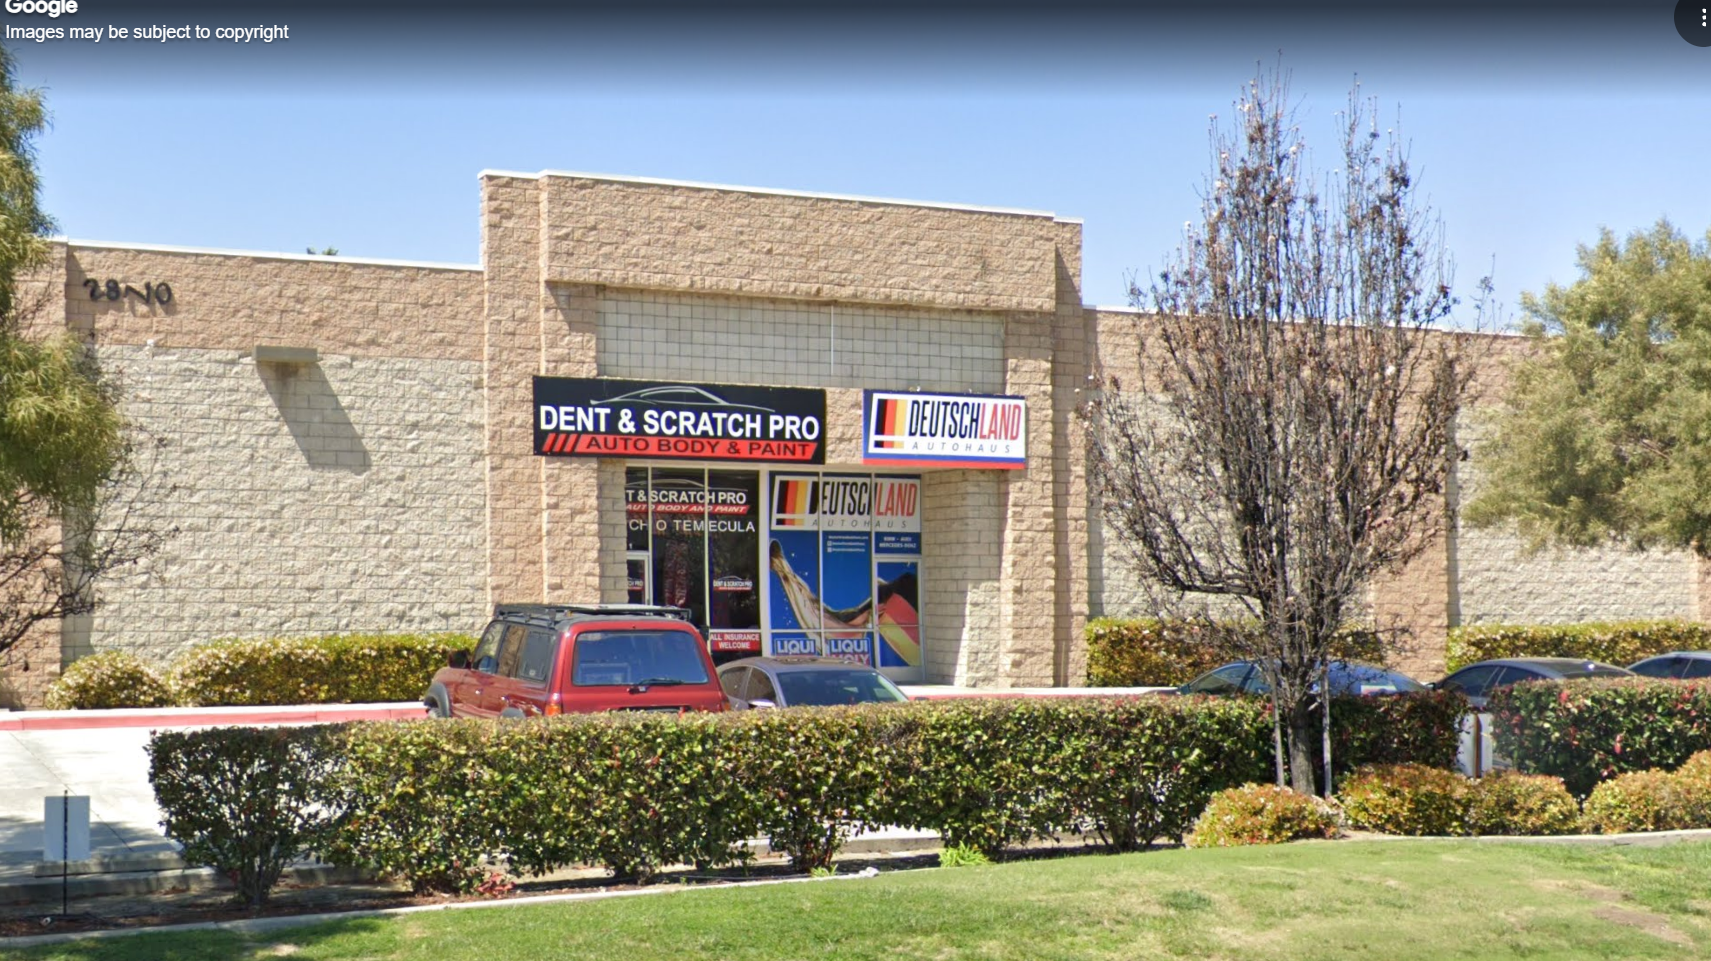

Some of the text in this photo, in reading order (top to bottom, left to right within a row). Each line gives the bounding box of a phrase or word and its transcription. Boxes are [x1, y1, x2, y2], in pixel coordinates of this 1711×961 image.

[540, 405, 820, 440] DENT & SCRATCH PRO
[908, 399, 1022, 441] DEUTSCHLAND
[586, 436, 810, 457] AUTO BODY & PAINT
[912, 441, 1011, 454] AUTOHAUS
[637, 490, 648, 502] &
[650, 490, 715, 504] SCRATCH
[718, 492, 747, 505] PRO
[626, 504, 655, 512] AUTO
[715, 505, 747, 513] PAINT
[673, 520, 756, 532] TEMECULA
[811, 519, 908, 528] AUTOHAUS
[718, 641, 751, 649] WELCOME
[777, 640, 815, 654] LIQUI
[831, 640, 868, 653] LIQUI
